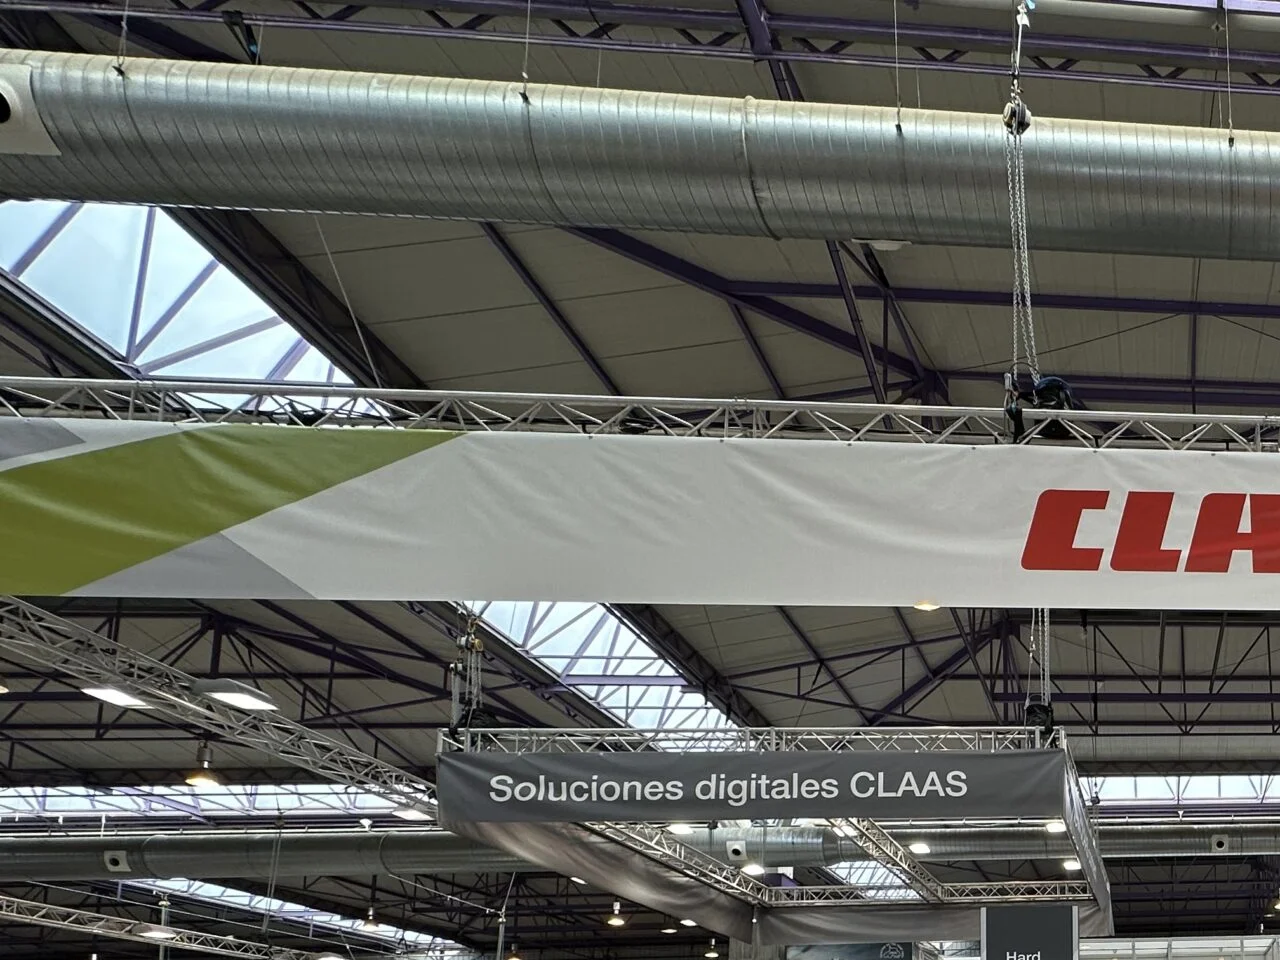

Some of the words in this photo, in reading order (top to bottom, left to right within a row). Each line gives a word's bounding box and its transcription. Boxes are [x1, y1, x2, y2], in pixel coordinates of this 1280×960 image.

[489, 774, 684, 802] Soluciones
[695, 771, 840, 806] digitales
[849, 770, 968, 798] CLAAS
